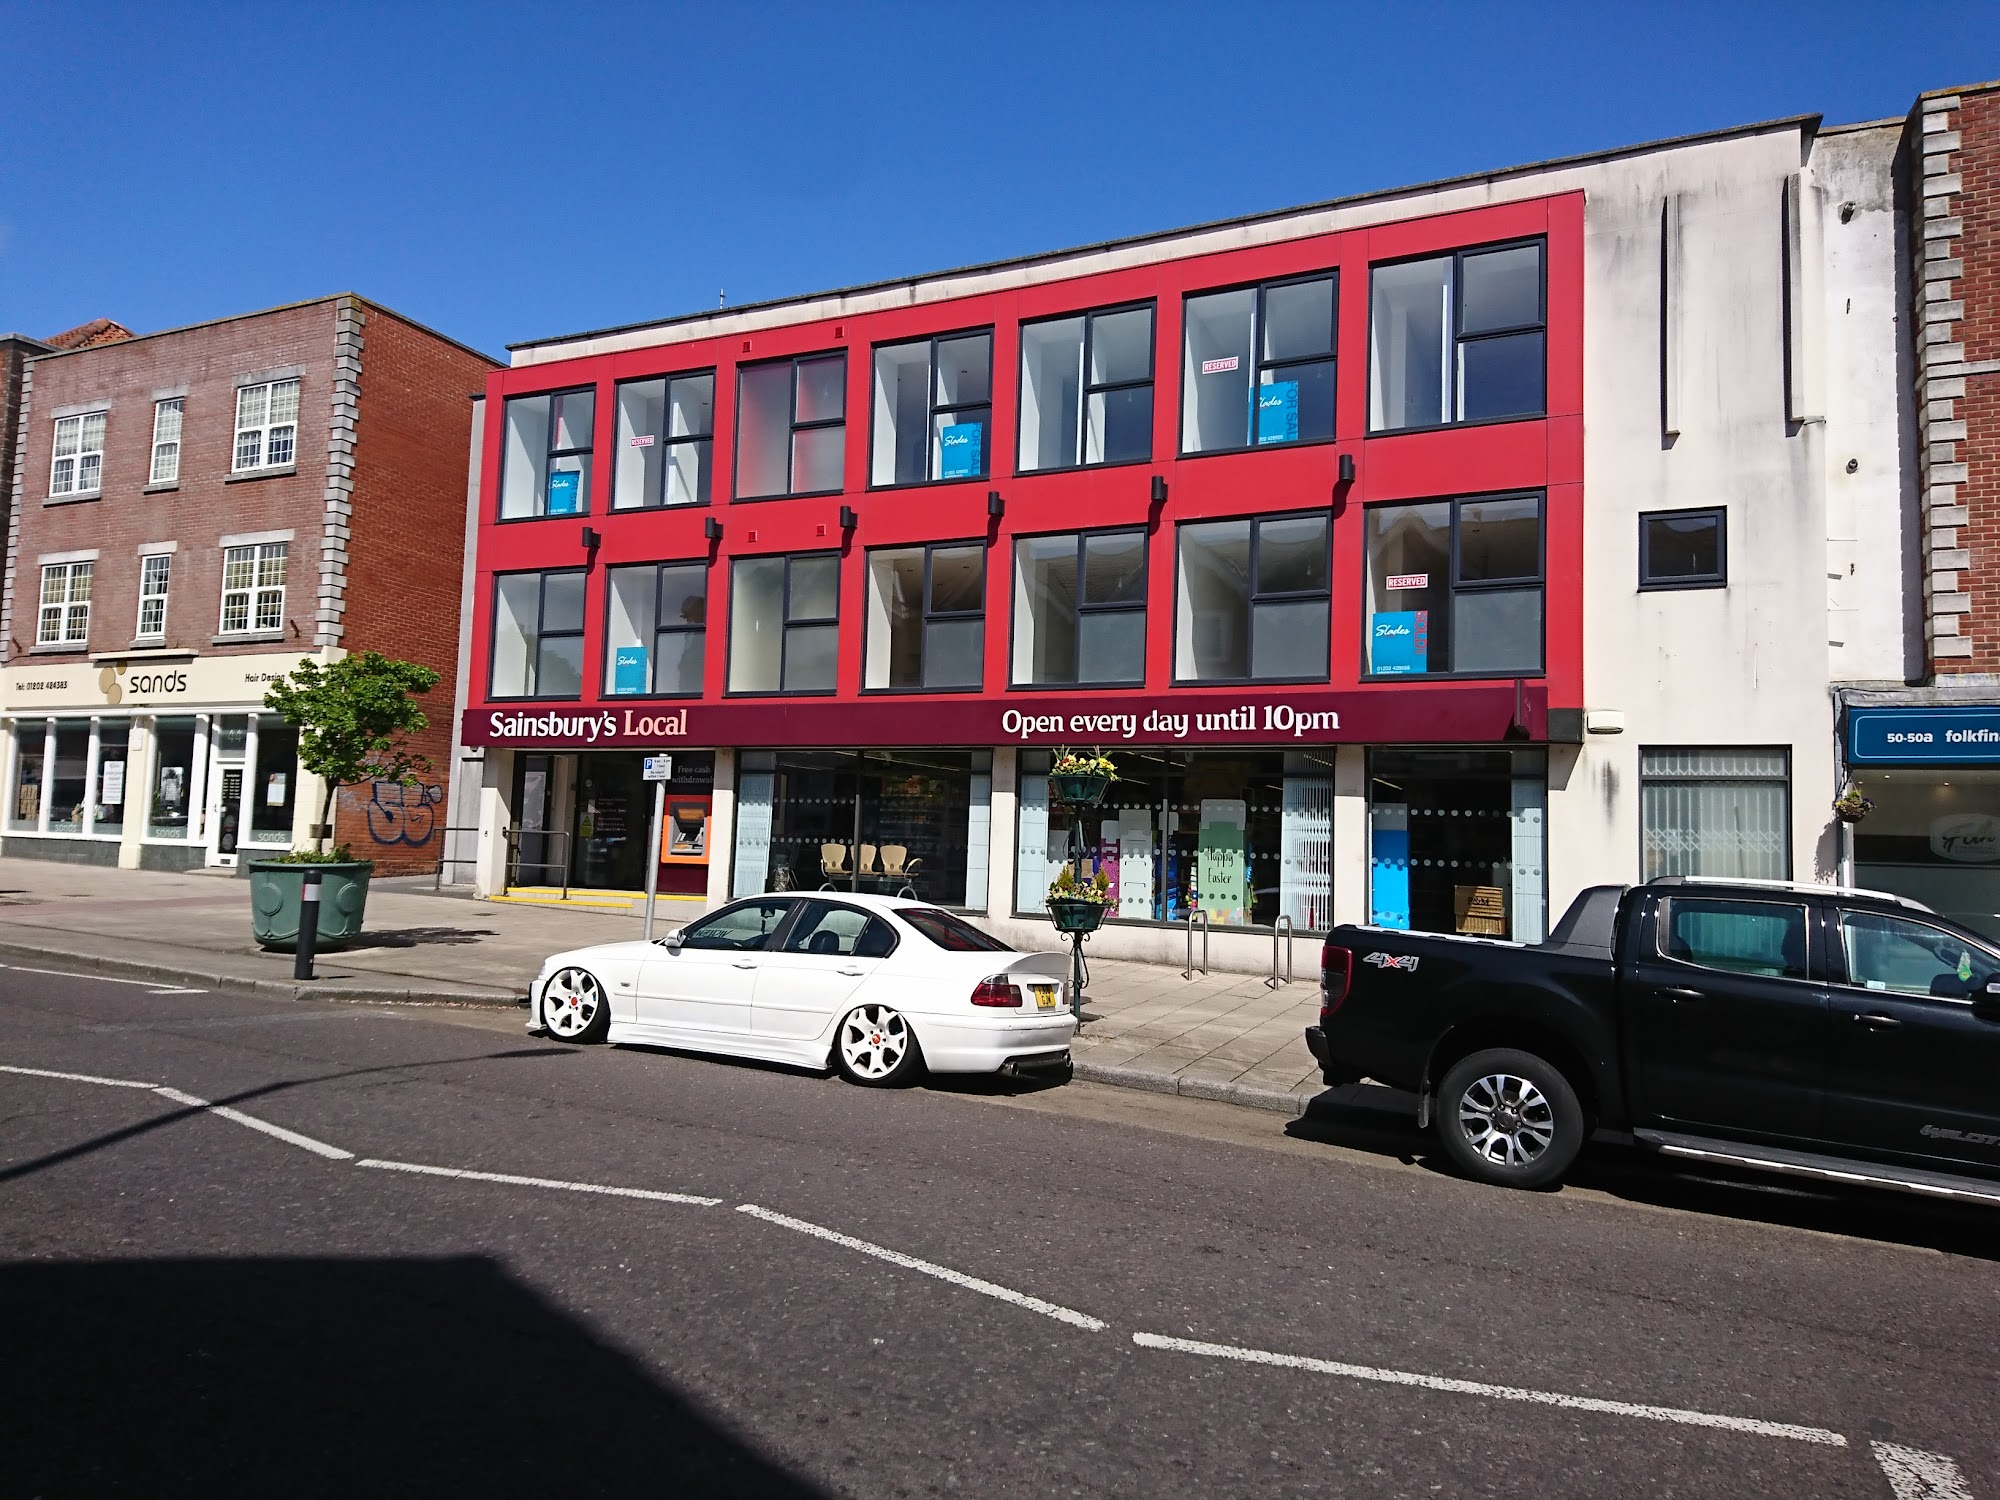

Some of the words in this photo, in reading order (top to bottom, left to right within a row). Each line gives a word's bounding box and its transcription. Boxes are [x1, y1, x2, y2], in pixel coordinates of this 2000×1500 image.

[1204, 359, 1236, 371] RESERVED
[1259, 395, 1283, 408] lades
[1286, 412, 1298, 440] SAL
[944, 435, 969, 447] Slades
[970, 450, 981, 475] SAL
[1388, 577, 1426, 588] RESERVED
[1375, 624, 1411, 637] Slades
[1414, 610, 1428, 649] SOLD
[617, 655, 638, 666] Slades
[129, 670, 187, 693] sands
[245, 673, 260, 683] Hair
[489, 710, 617, 743] Sainsbury's
[622, 709, 687, 736] Local
[1001, 709, 1065, 739] Open
[1069, 713, 1137, 738] every
[1143, 709, 1189, 738] day
[1195, 705, 1257, 731] until
[1263, 704, 1340, 737] 10pm
[1886, 732, 1934, 743] 50-50a
[1945, 729, 2000, 743] folkfin
[677, 766, 693, 774] Free
[694, 766, 711, 774] cash
[155, 827, 181, 838] sands
[257, 831, 286, 842] sands
[1207, 867, 1232, 884] Easter
[1919, 1124, 2000, 1147] WILDT
